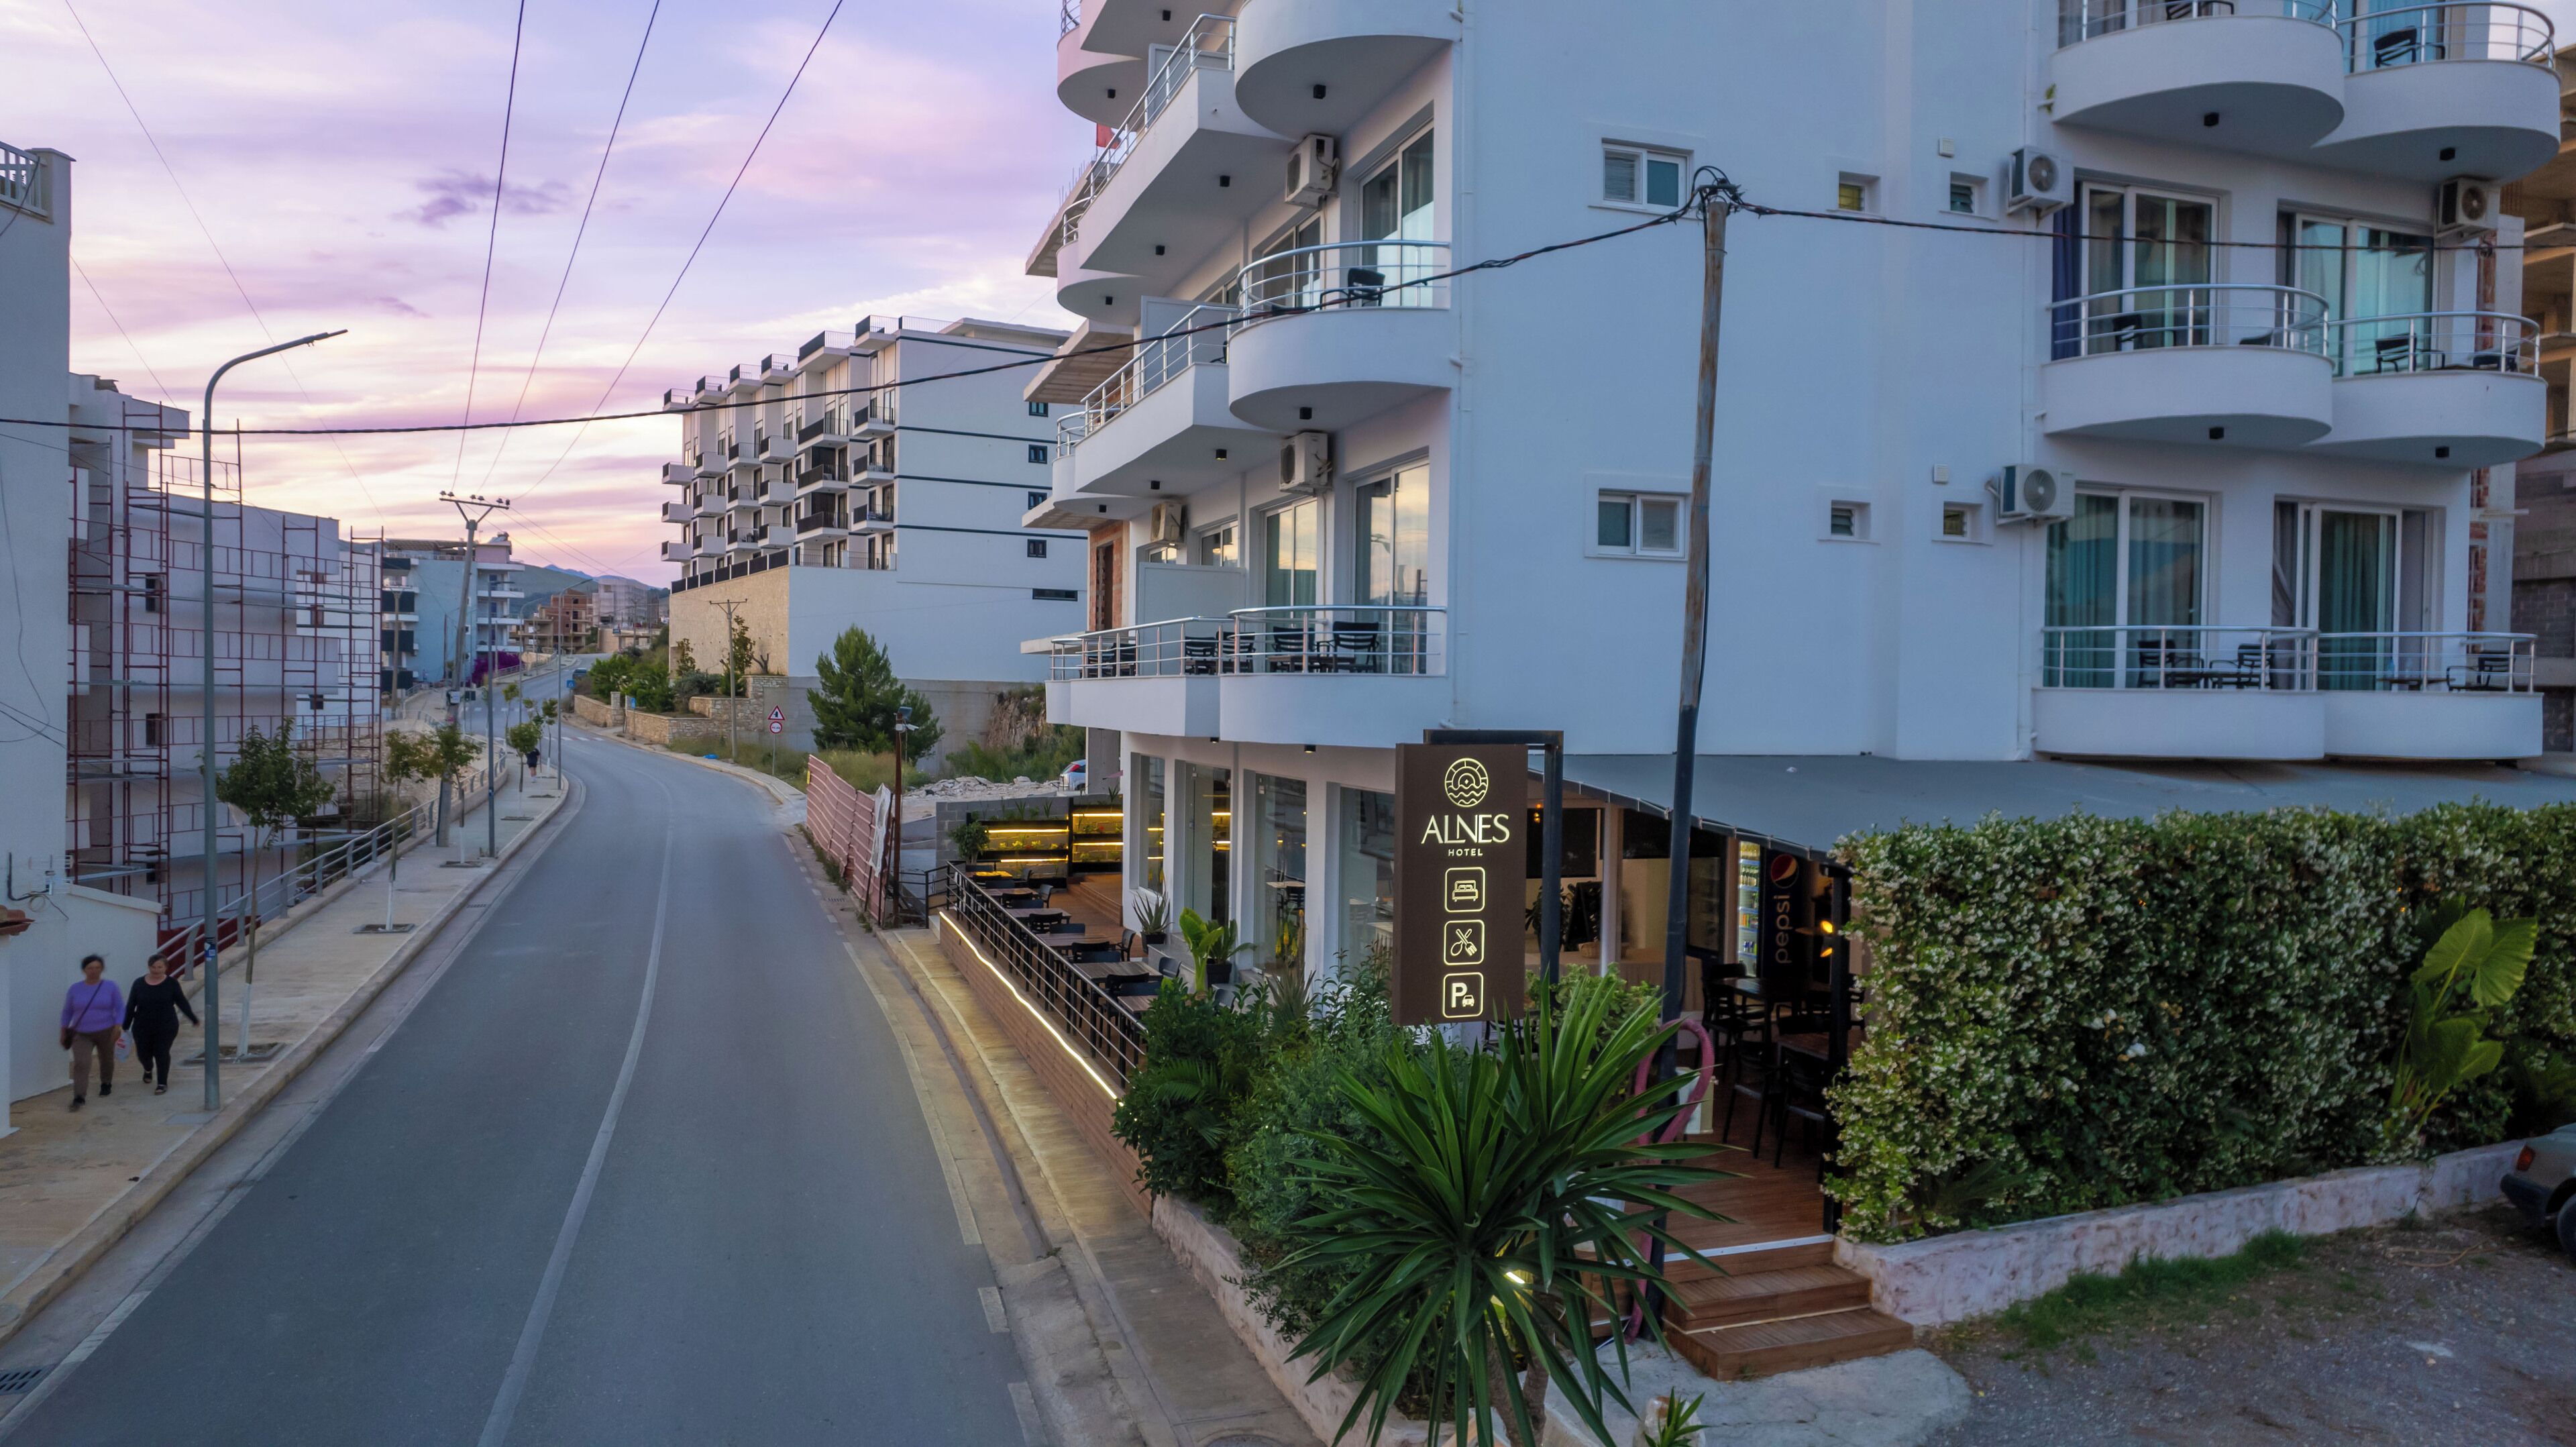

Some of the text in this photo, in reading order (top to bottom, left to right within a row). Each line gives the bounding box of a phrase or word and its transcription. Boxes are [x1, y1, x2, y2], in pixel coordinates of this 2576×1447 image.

[1421, 814, 1510, 844] ALNES
[1448, 848, 1483, 857] HOTEL
[1773, 894, 1792, 964] pepsi
[1451, 982, 1468, 1008] P
